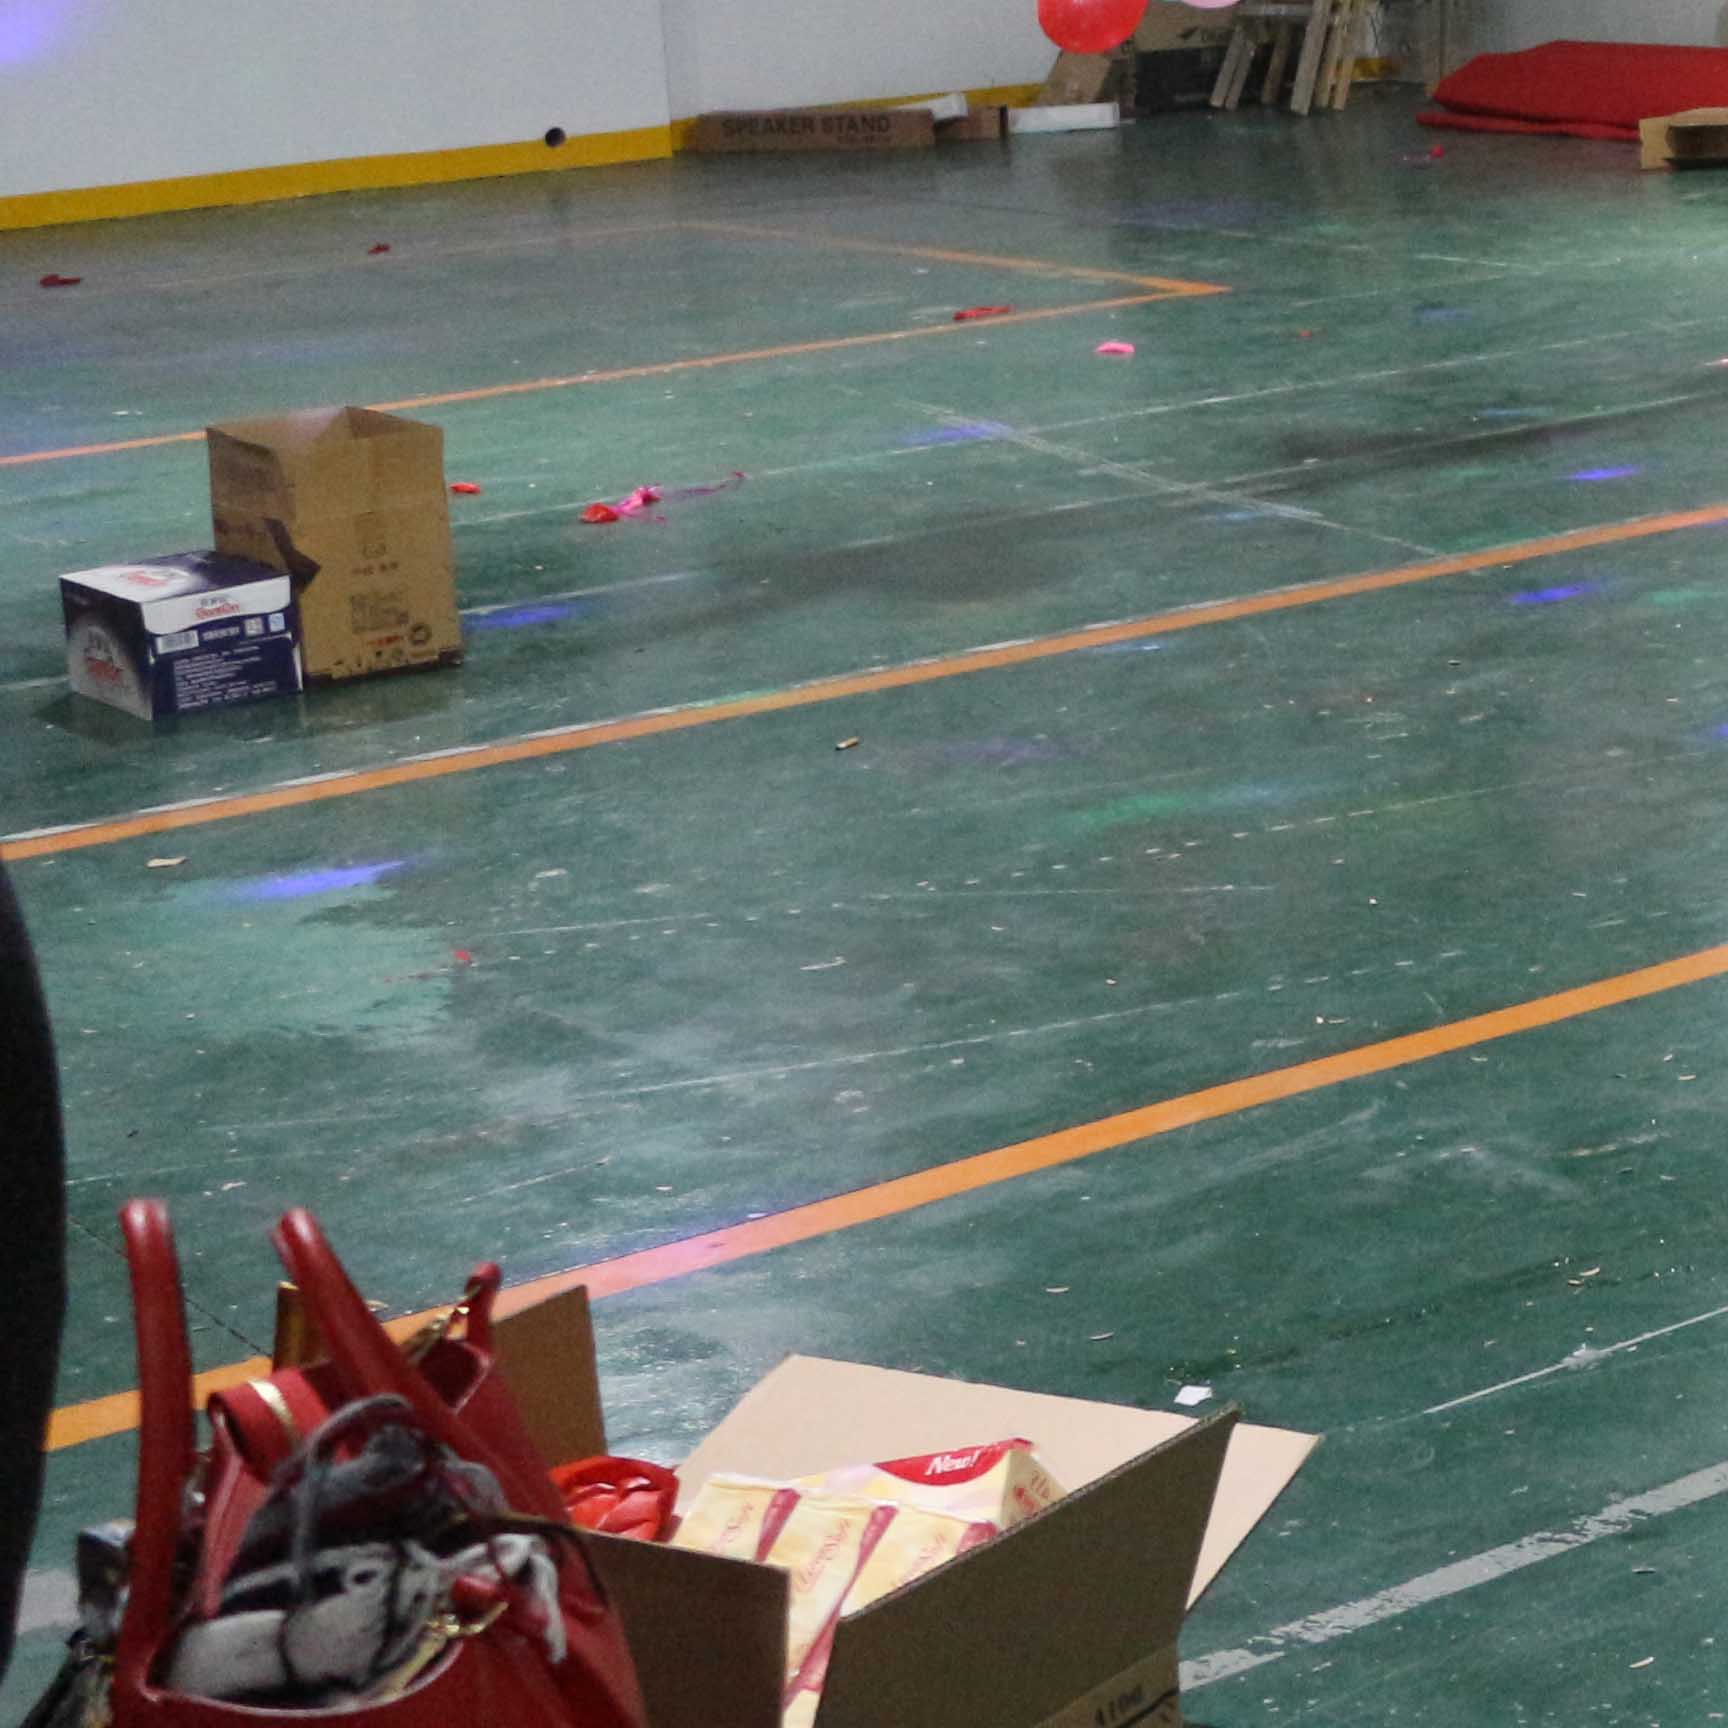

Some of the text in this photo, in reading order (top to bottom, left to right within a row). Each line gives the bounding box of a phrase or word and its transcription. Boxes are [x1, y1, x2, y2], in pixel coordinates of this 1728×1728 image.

[722, 114, 889, 136] SPEAKER STAND
[923, 1450, 982, 1476] New!
